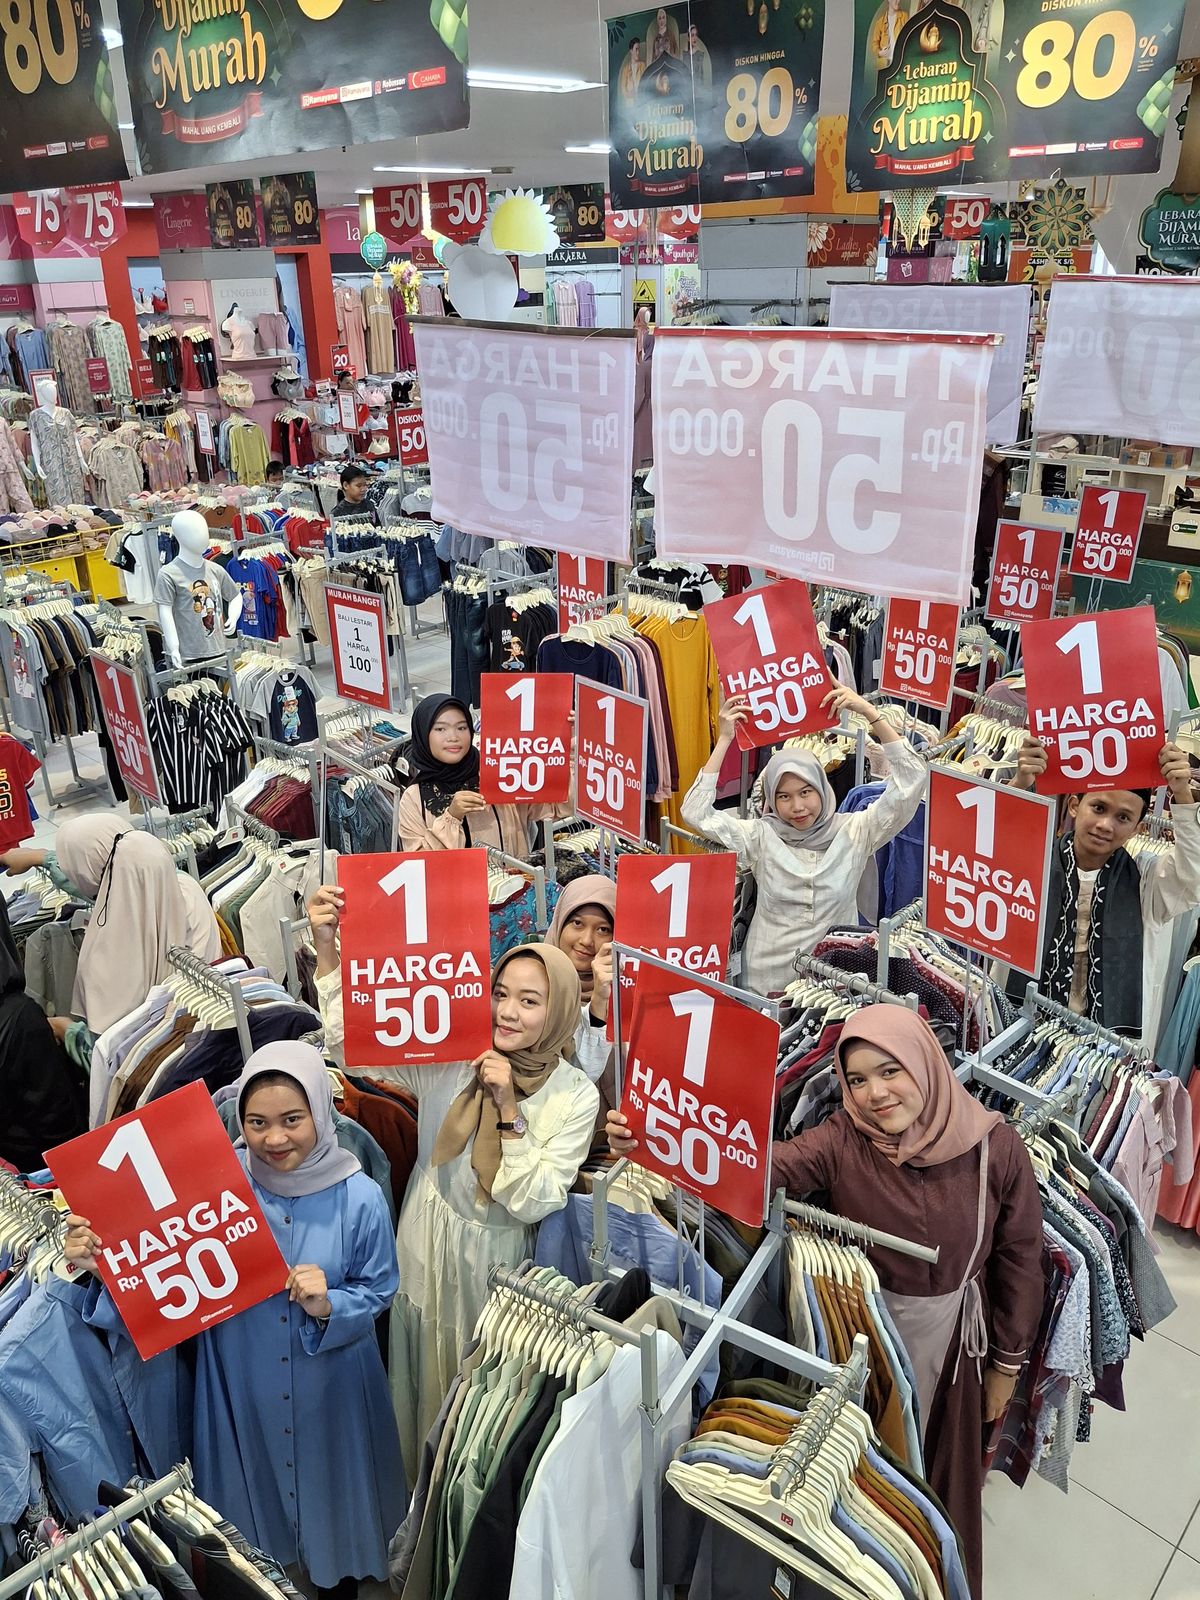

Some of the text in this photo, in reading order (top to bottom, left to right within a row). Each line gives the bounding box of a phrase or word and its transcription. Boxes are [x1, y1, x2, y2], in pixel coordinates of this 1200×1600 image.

[152, 11, 267, 109] Murah
[735, 50, 785, 67] DISKON HINGGA
[903, 61, 957, 81] Lebaran
[887, 77, 971, 114] Dijamin
[182, 116, 241, 136] MAHAL UANG KEMBALI
[870, 99, 983, 154] Murah
[627, 135, 704, 179] Murah
[894, 159, 953, 171] MAHAL UANG KEMBALI
[950, 200, 986, 230] 50
[219, 287, 269, 299] LINGERIE
[1097, 491, 1120, 529] 1
[1017, 529, 1036, 564] 1
[1077, 528, 1133, 548] HARGA
[1082, 543, 1118, 572] 50
[560, 584, 603, 603] HARGA
[999, 575, 1040, 609] 50
[1000, 563, 1050, 581] HARGA
[327, 588, 381, 608] MURAH BANGET
[353, 627, 362, 642] 1
[732, 593, 777, 657] 1
[893, 626, 948, 651] HARGA
[346, 641, 371, 653] HARGA
[348, 655, 372, 673] 100
[894, 641, 936, 685] 50
[1055, 620, 1103, 695] 1
[105, 666, 126, 714] 1
[727, 651, 821, 694] HARGA
[106, 707, 143, 740] HARGA
[505, 678, 536, 733] 1
[597, 695, 616, 747] 1
[748, 681, 808, 732] 50
[1035, 697, 1155, 732] HARGA
[113, 726, 145, 776] 50
[485, 736, 565, 756] HARGA
[583, 738, 637, 775] HARGA
[1058, 727, 1129, 780] 50
[498, 756, 546, 794] 50
[586, 757, 625, 812] 50
[955, 785, 996, 860] 1
[929, 846, 1036, 906] HARGA
[377, 859, 429, 945] 1
[650, 862, 692, 938] 1
[944, 876, 1009, 942] 50
[350, 951, 483, 986] HARGA
[373, 984, 451, 1048] 50
[668, 988, 716, 1088] 1
[631, 1058, 758, 1151] HARGA
[97, 1118, 178, 1212] 1
[645, 1102, 721, 1187] 50
[102, 1189, 251, 1276] HARGA
[141, 1237, 240, 1321] 50
